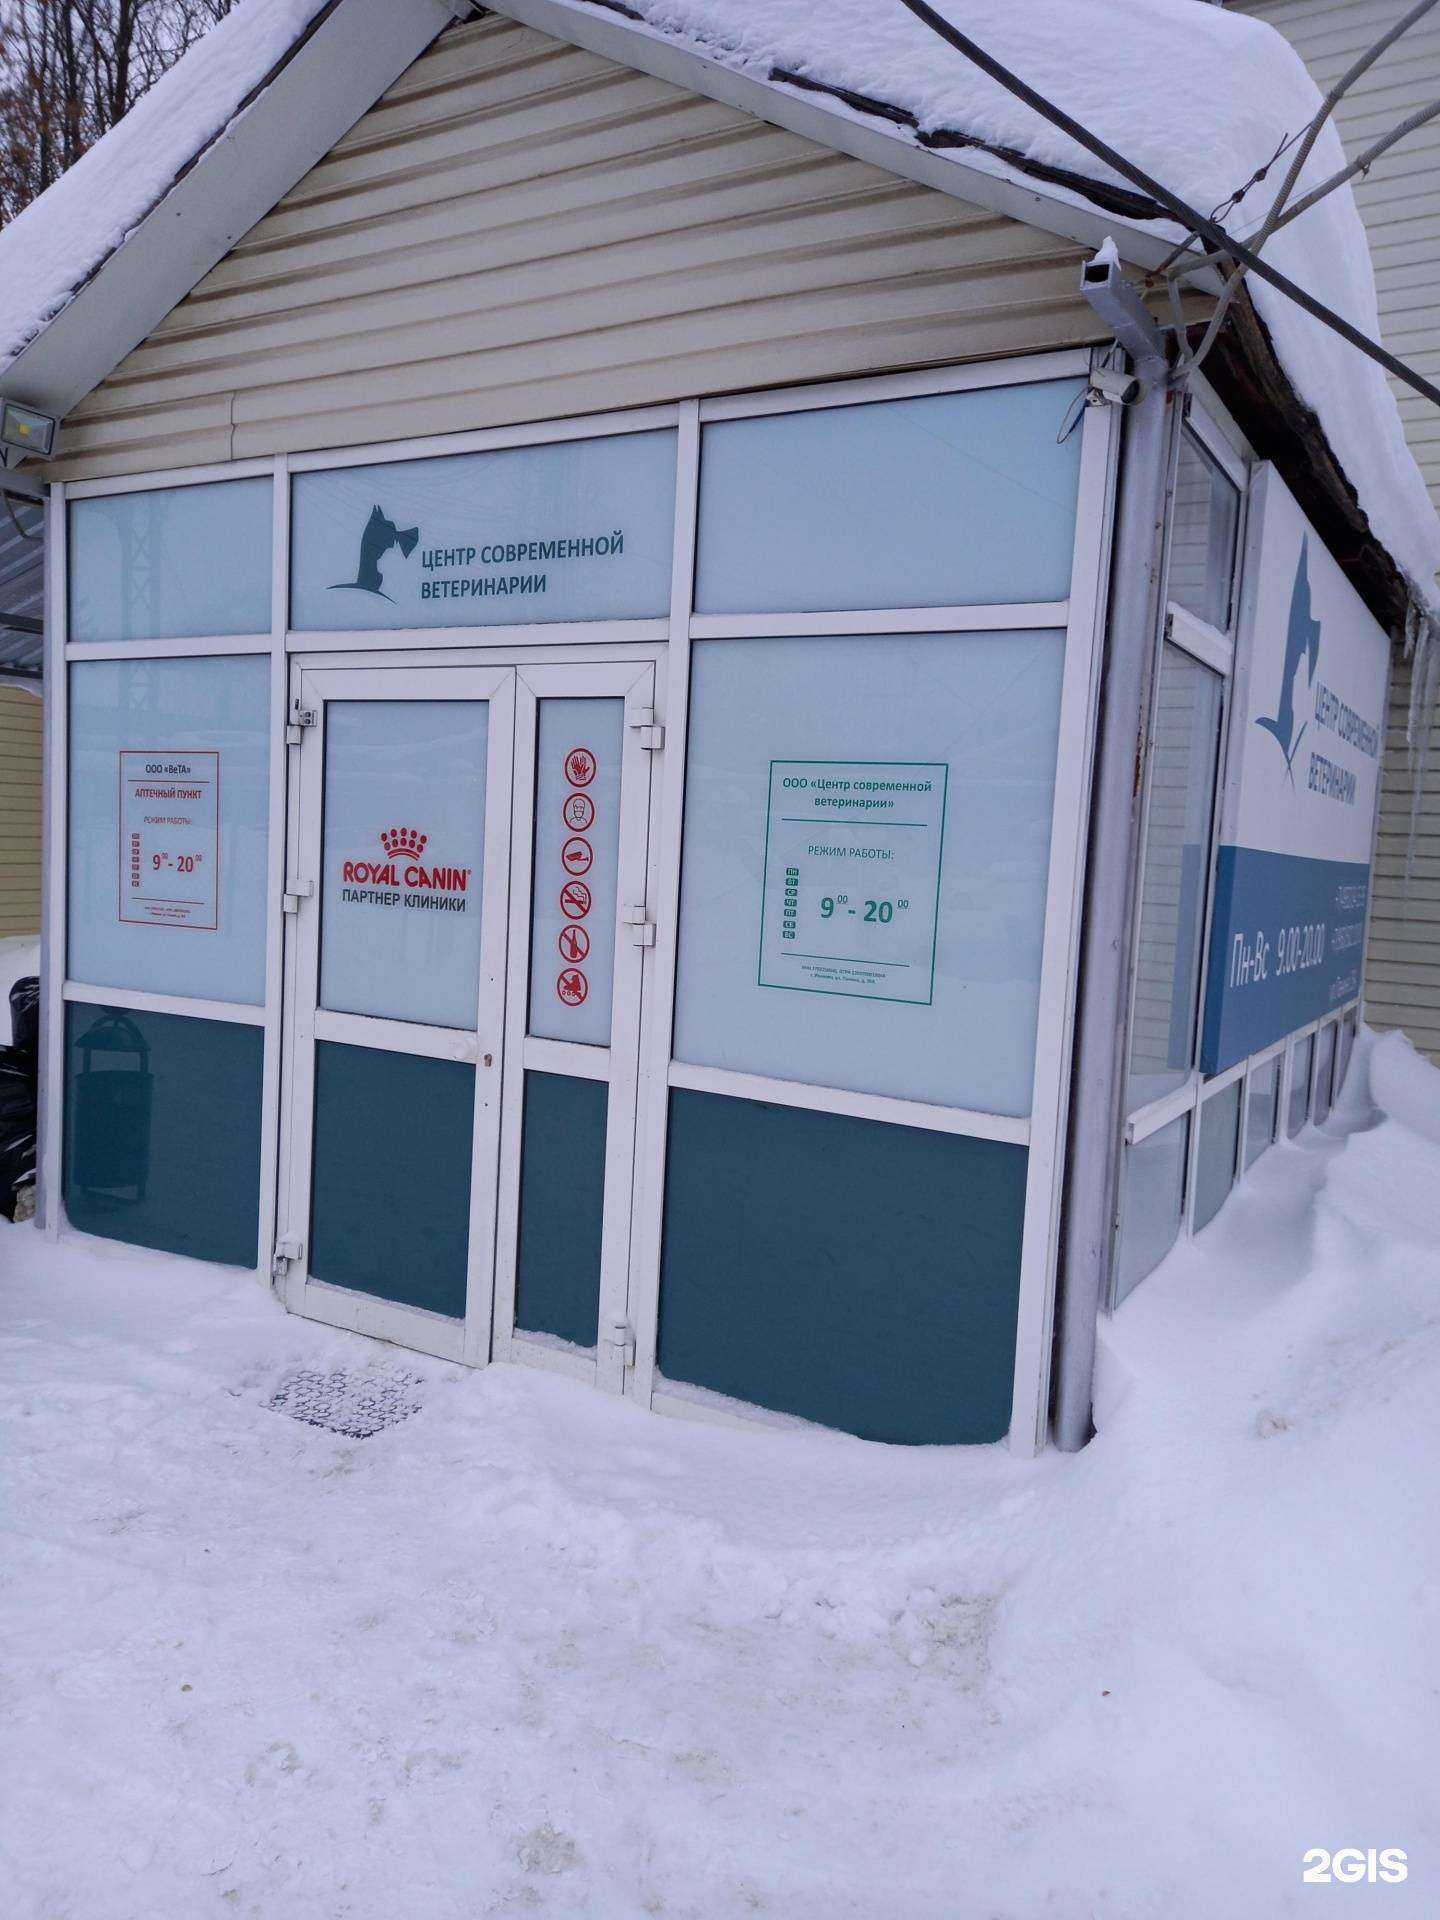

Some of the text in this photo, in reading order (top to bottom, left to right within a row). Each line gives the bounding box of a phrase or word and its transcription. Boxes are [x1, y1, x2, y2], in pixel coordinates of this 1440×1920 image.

[421, 530, 624, 571] ЦЕНТР СОВРЕМЕННОЙ
[421, 574, 546, 599] ВЕТЕРИНАРИИ
[145, 764, 163, 774] ООО
[135, 787, 202, 799] АПТЕЧНЫЙ ПУНКТ
[783, 778, 932, 793] ООО «Центр современной
[814, 797, 894, 811] ветеринарии»
[808, 846, 895, 860] РЕЖИМ РАБОТЫ:
[343, 862, 467, 891] ROYAL CANIN
[342, 889, 466, 912] ПАРТНЕР КЛИНИКИ
[1230, 930, 1270, 989] Пн-Вс
[1275, 922, 1326, 977] 9.00-20.00
